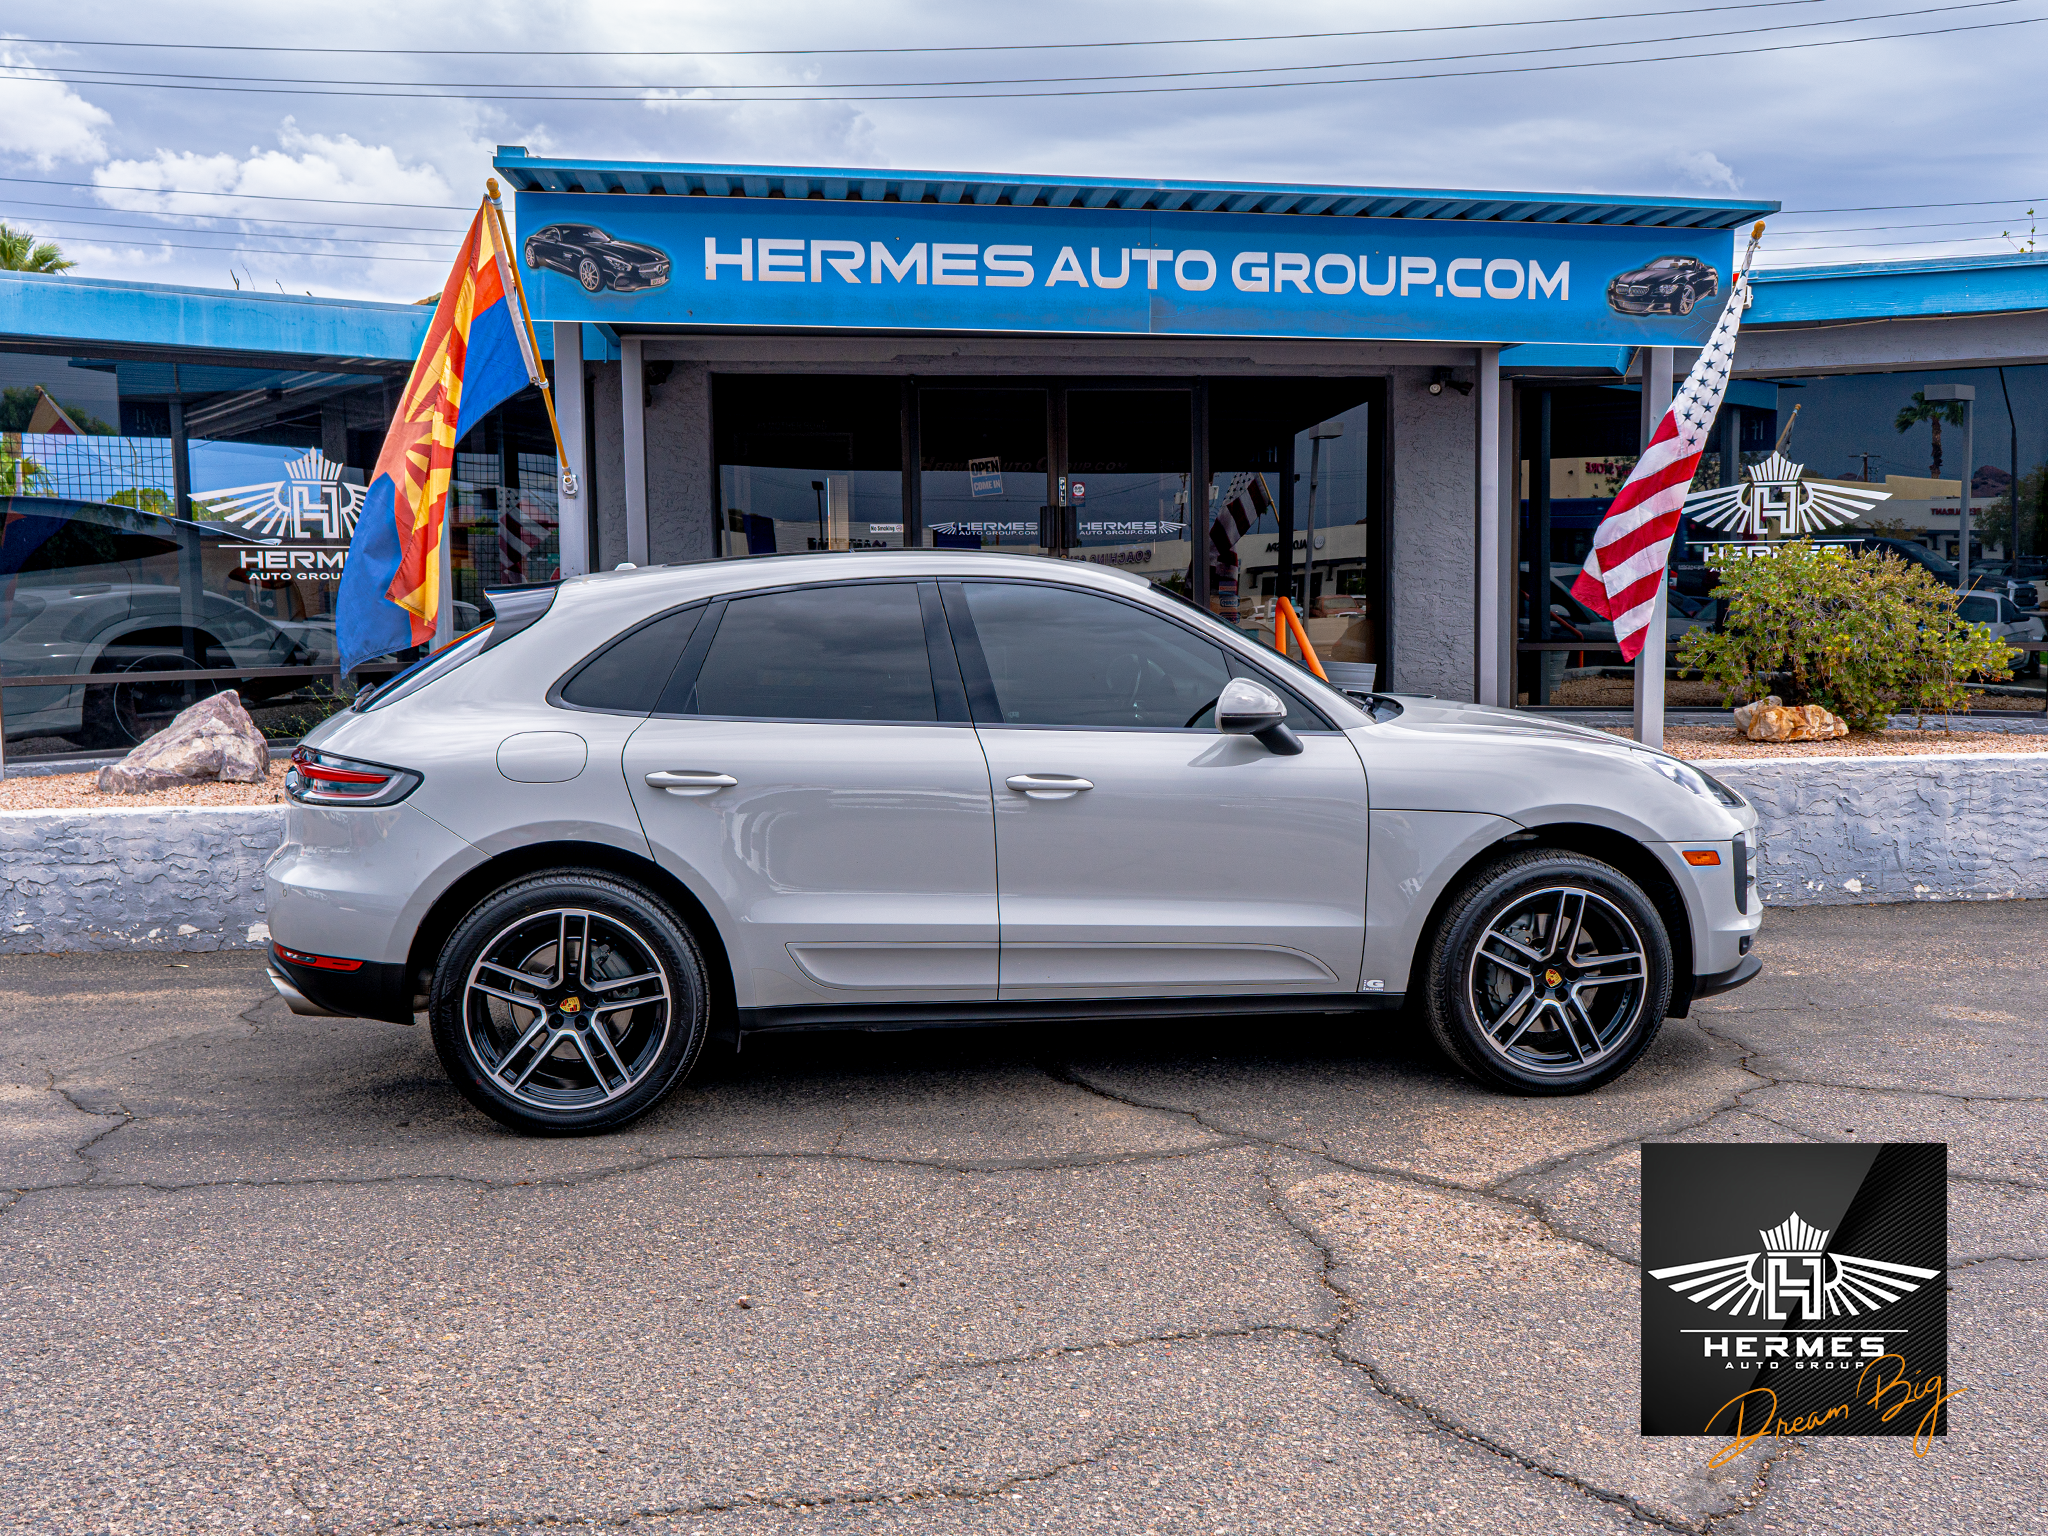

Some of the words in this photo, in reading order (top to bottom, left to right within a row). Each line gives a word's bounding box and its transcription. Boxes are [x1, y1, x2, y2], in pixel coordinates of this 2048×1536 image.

[705, 237, 1035, 287] HERMES
[1044, 246, 1217, 291] AUTO
[1231, 251, 1571, 301] GROUP.COM
[971, 460, 999, 476] OPEN
[974, 480, 993, 491] COME
[993, 479, 1001, 489] IN
[958, 522, 1038, 531] HERMES
[1079, 522, 1157, 530] HERMES
[240, 551, 349, 569] HERM
[248, 572, 292, 580] AUTO
[296, 572, 343, 580] GROU
